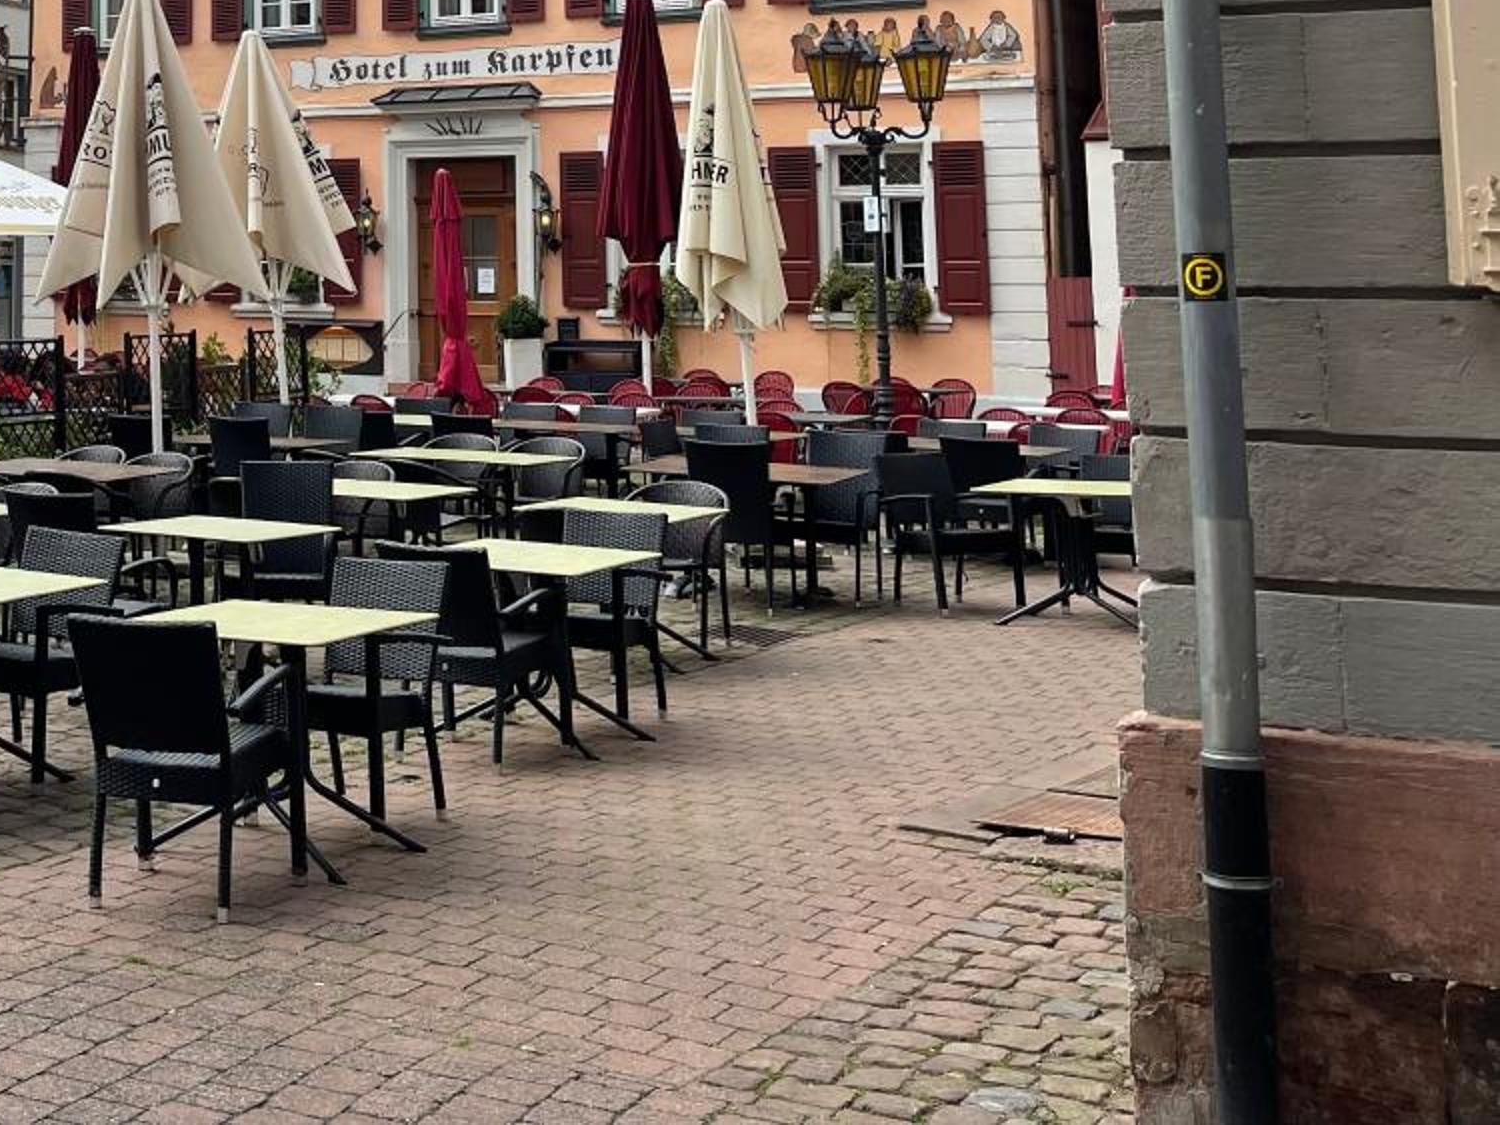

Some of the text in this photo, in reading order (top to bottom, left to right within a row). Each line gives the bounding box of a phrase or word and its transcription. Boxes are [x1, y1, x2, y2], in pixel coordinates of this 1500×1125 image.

[329, 44, 613, 83] Hotel zum Karpfen
